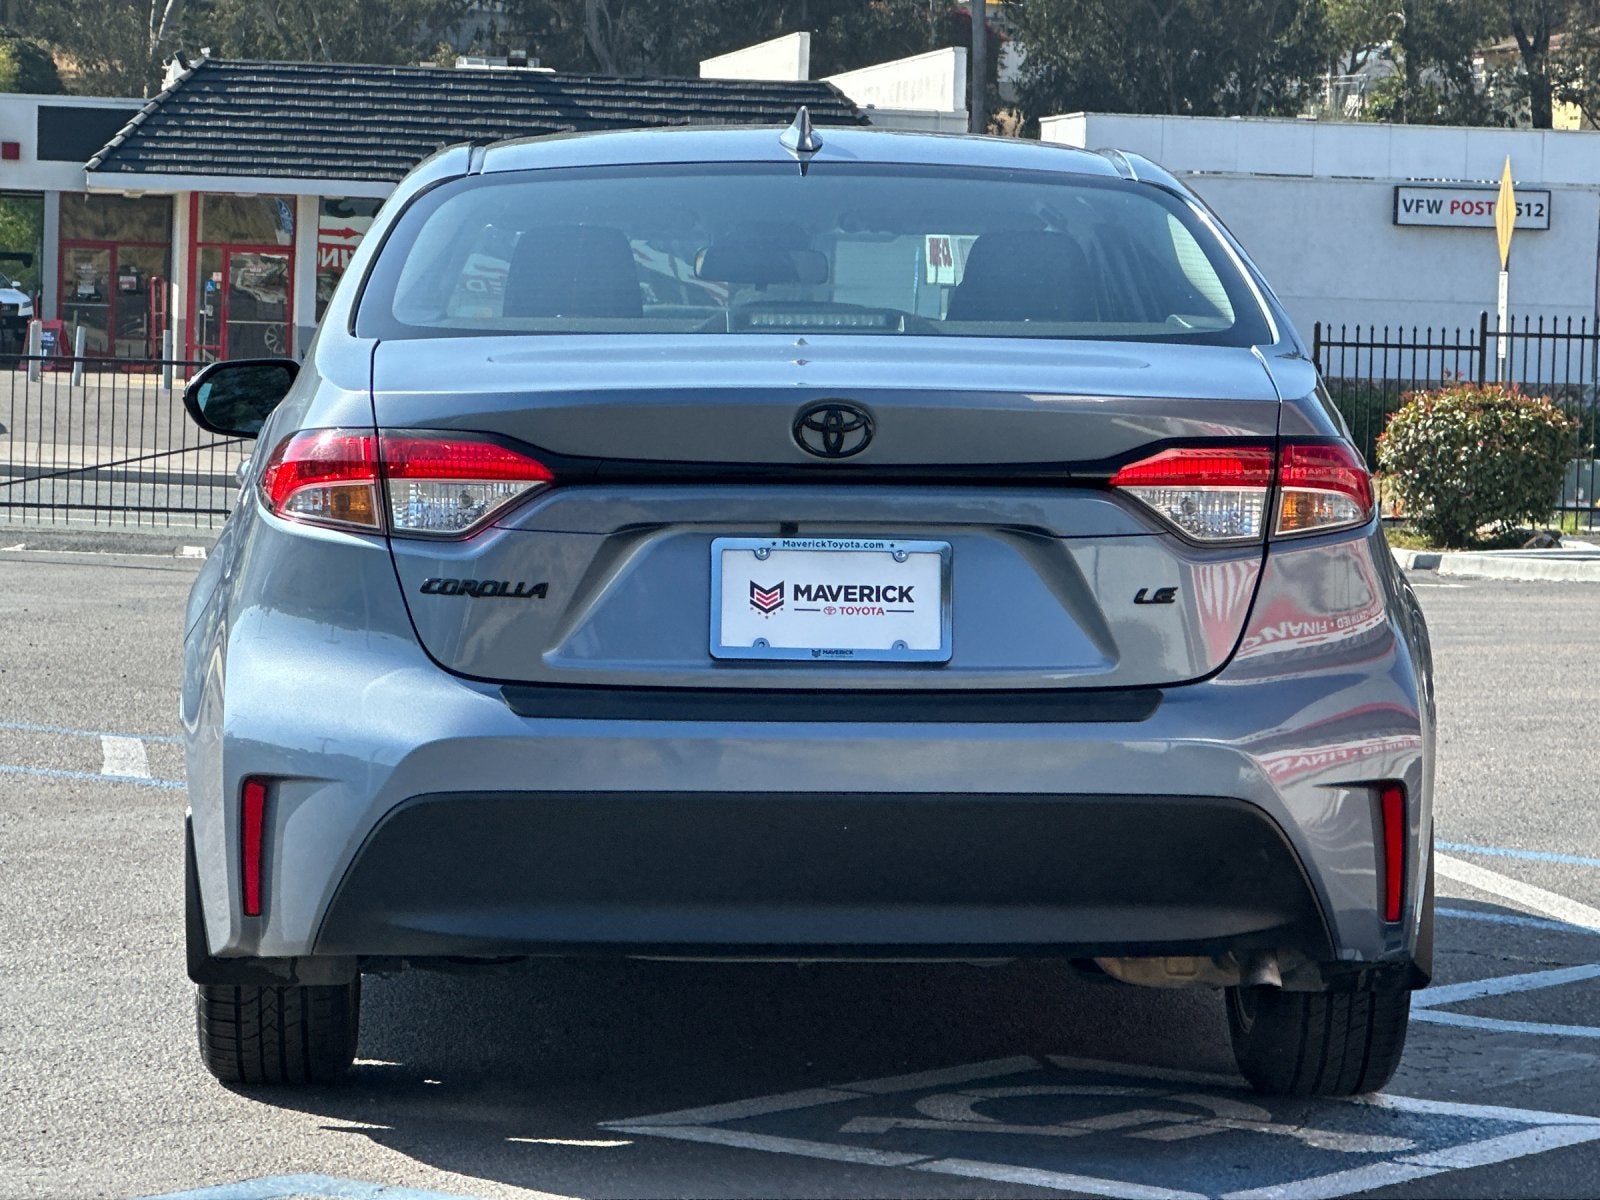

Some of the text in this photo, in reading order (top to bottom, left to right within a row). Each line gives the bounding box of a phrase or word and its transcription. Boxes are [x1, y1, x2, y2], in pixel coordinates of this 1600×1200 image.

[1402, 199, 1544, 217] VFW POST 512
[782, 540, 884, 549] MaverickToyota.com
[420, 578, 549, 598] COROLLA
[793, 584, 915, 603] MAVERICK
[1134, 587, 1178, 604] LE
[839, 607, 885, 616] TOYOTA
